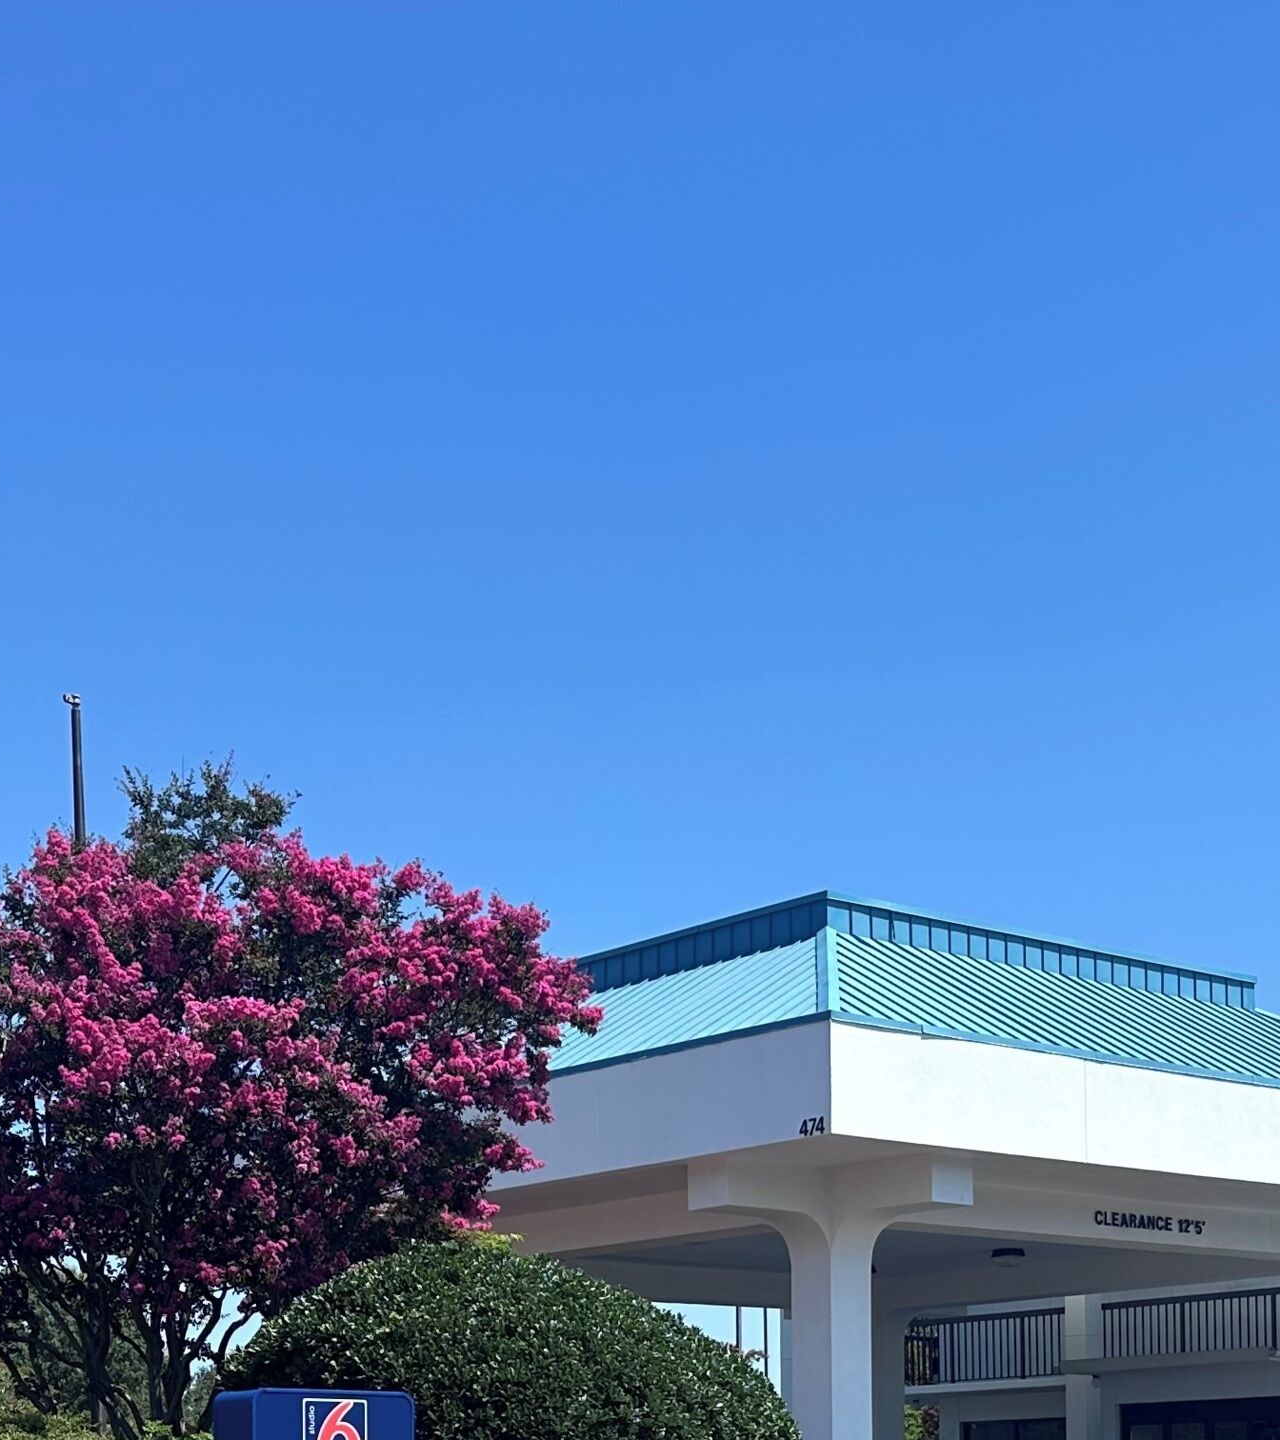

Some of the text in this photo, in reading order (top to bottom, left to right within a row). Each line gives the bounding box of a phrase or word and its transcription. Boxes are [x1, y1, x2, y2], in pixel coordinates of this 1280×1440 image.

[799, 1115, 825, 1136] 474
[1094, 1210, 1173, 1231] CLEARANCE
[308, 1405, 316, 1435] studio
